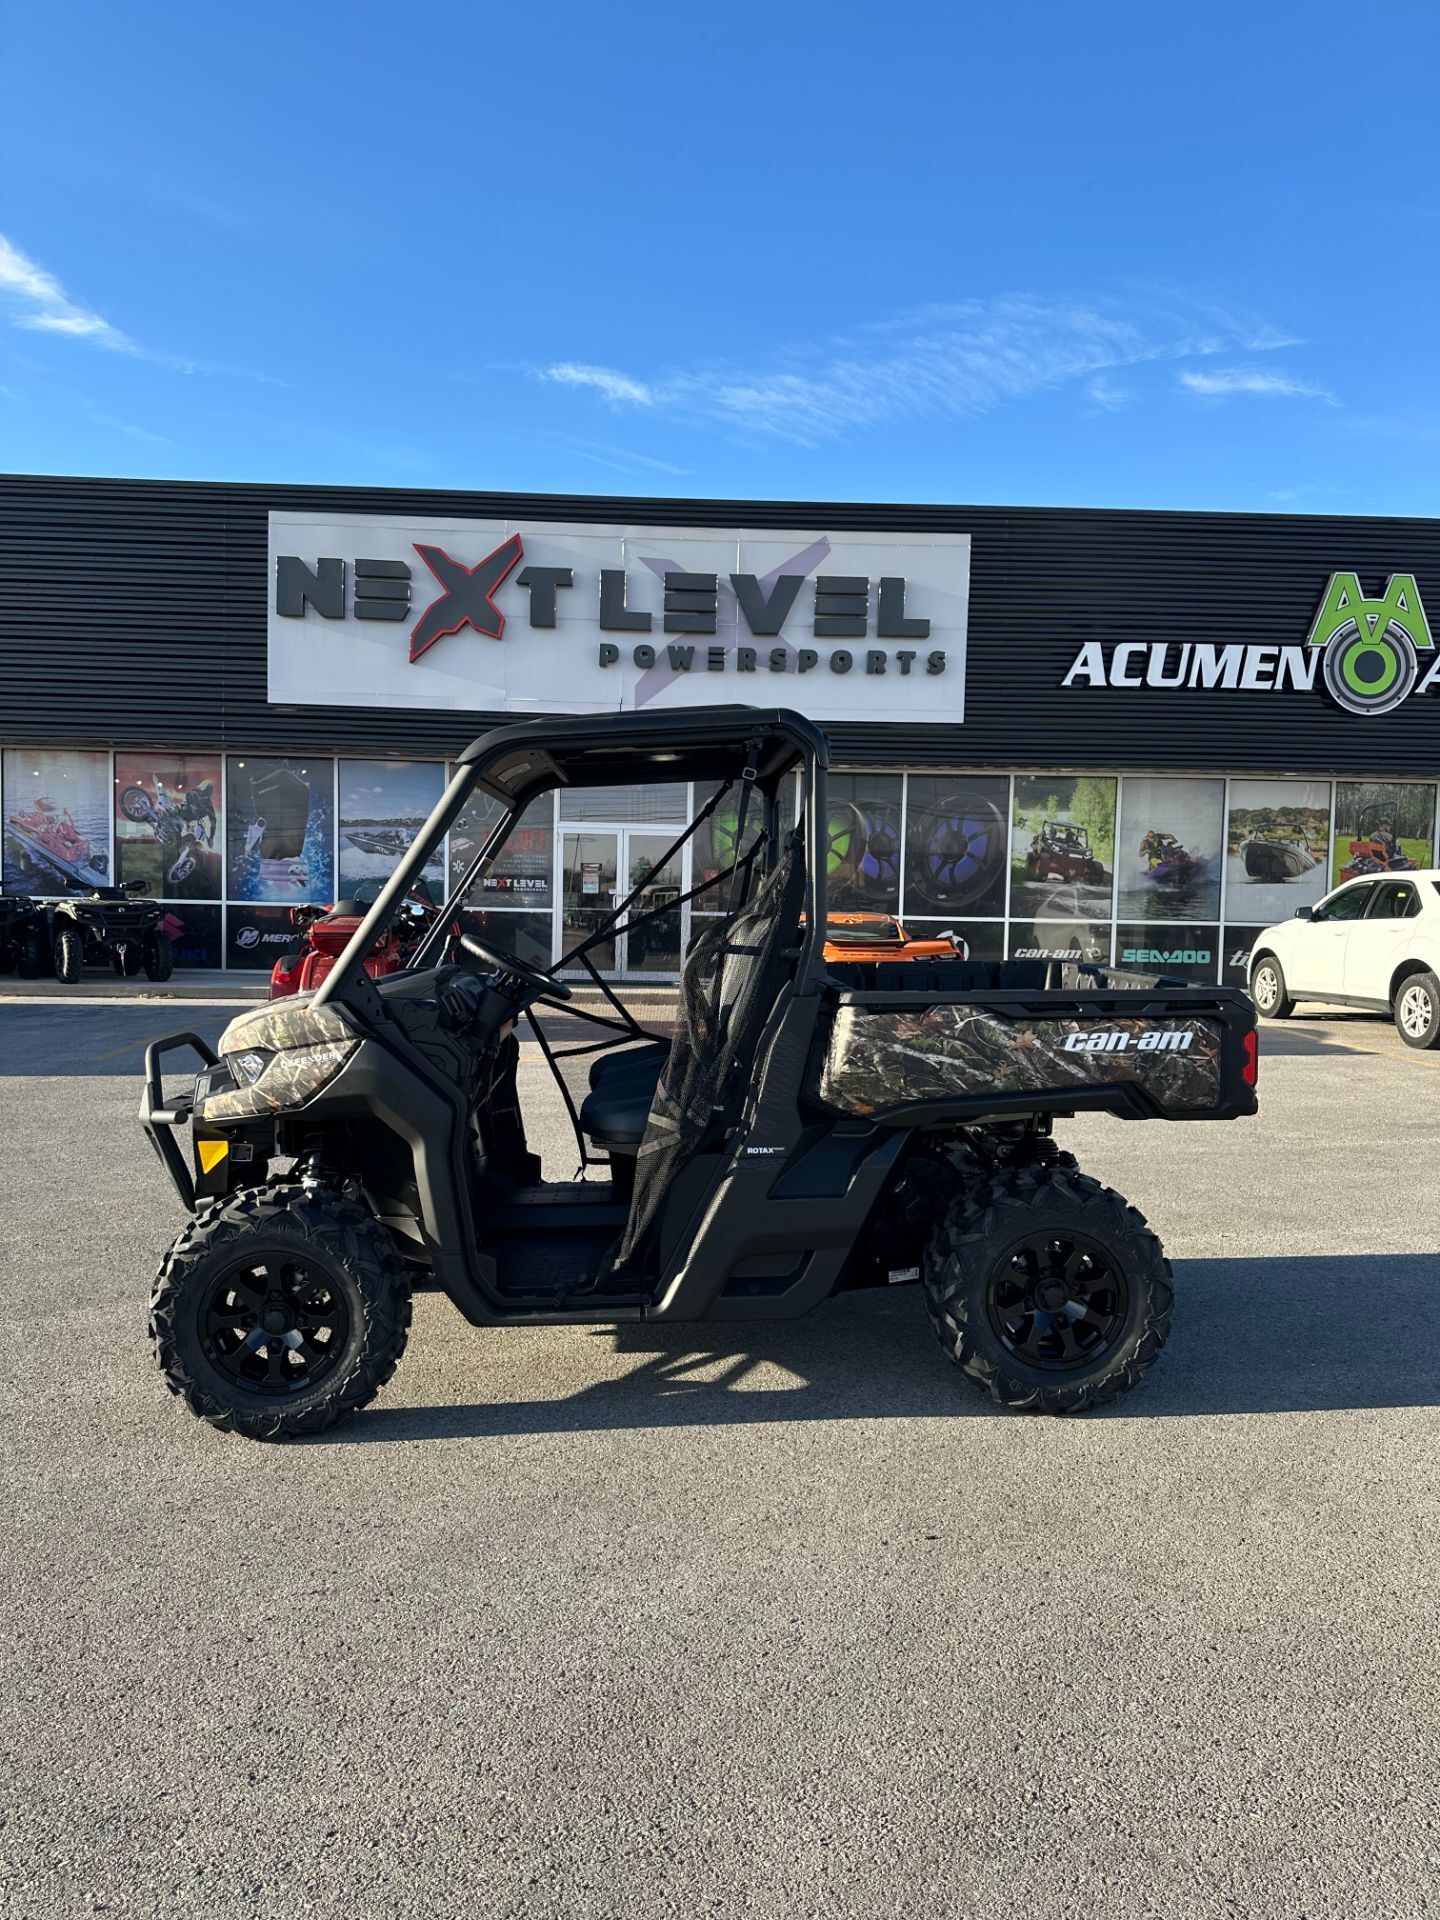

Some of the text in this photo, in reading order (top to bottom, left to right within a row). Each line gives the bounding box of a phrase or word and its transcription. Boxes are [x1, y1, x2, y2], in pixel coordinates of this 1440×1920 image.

[276, 533, 930, 664] NEXT LEVEL
[599, 643, 947, 676] POWERSPORTS
[1061, 641, 1321, 691] ACUMEN
[483, 876, 548, 889] NEXT LEVEL
[1014, 948, 1082, 959] can-am
[1064, 1030, 1193, 1052] can-am
[280, 1051, 336, 1068] DEFENDER
